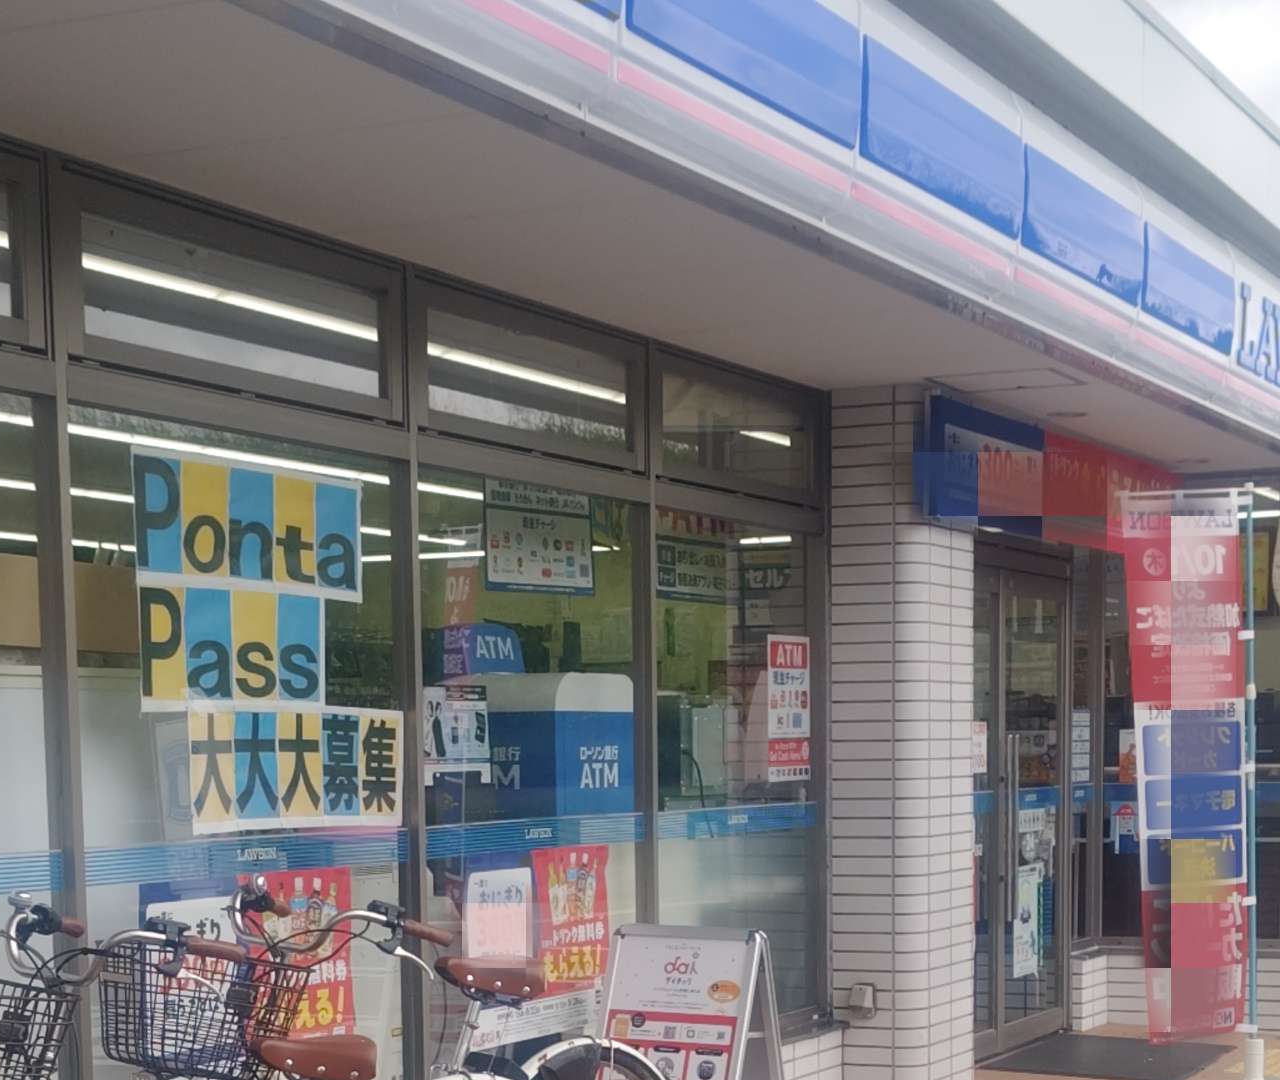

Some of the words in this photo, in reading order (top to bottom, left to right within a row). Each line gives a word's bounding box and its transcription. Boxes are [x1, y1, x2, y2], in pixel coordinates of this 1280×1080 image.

[132, 453, 358, 593] Ponta
[141, 587, 320, 701] Pass
[476, 634, 515, 661] ATM
[776, 644, 803, 666] ATM
[189, 710, 400, 817] 大大大募集
[579, 762, 619, 789] ATM
